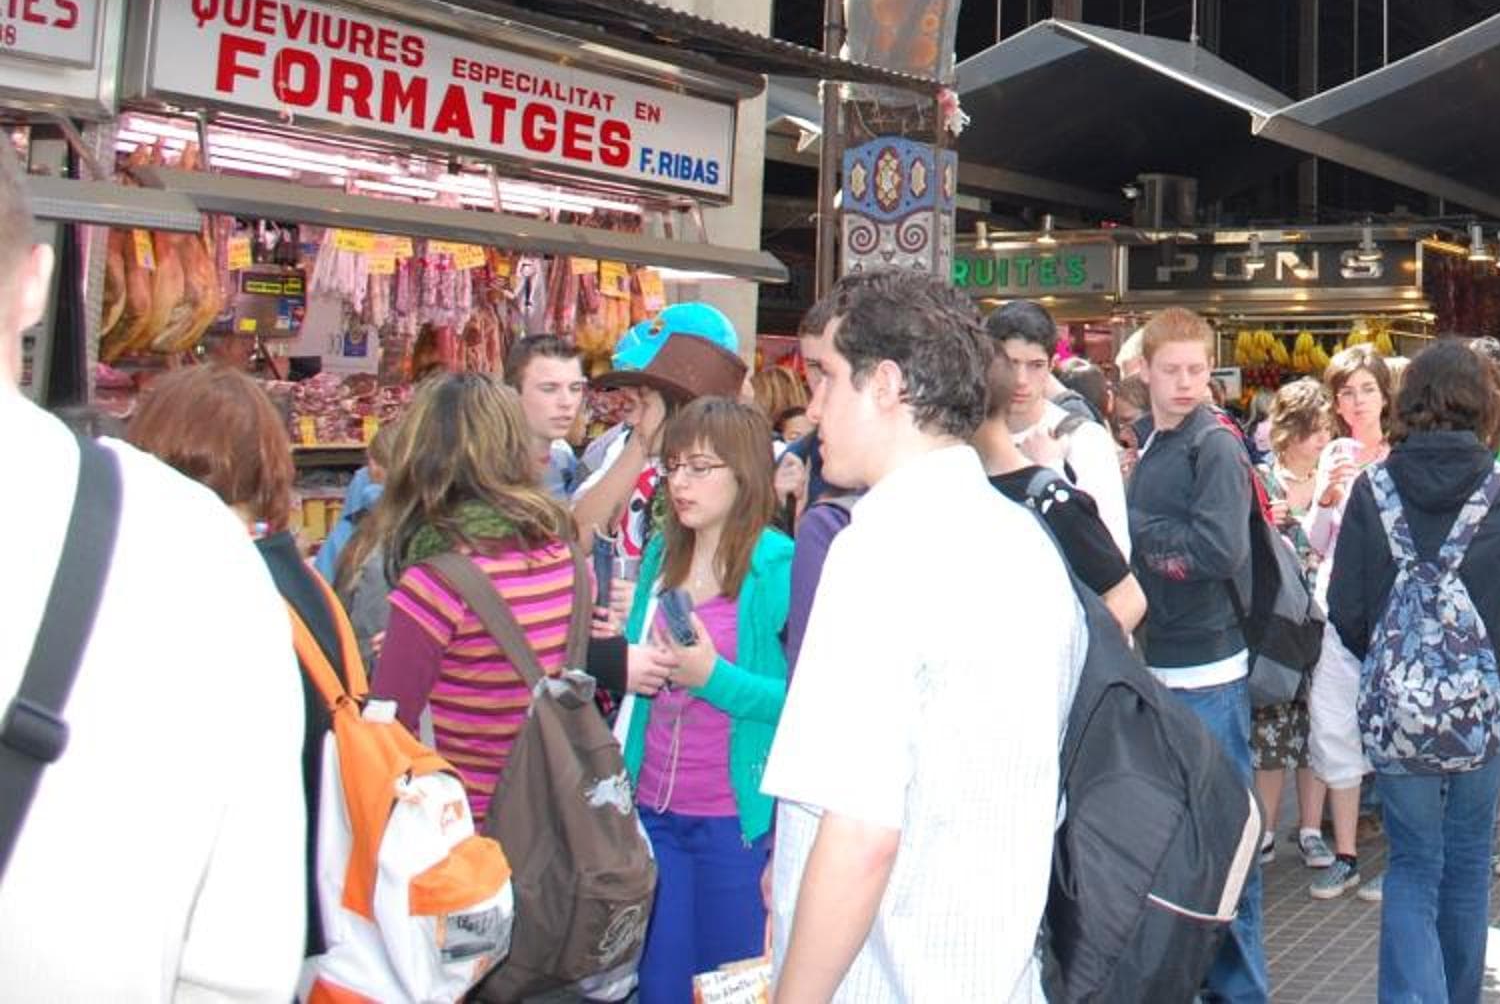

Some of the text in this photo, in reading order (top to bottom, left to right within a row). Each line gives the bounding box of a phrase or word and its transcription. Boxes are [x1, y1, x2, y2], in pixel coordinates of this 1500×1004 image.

[215, 32, 633, 169] FORMATGES
[452, 57, 663, 124] ESPECIALITAT EN
[639, 146, 720, 186] F.RIBAS
